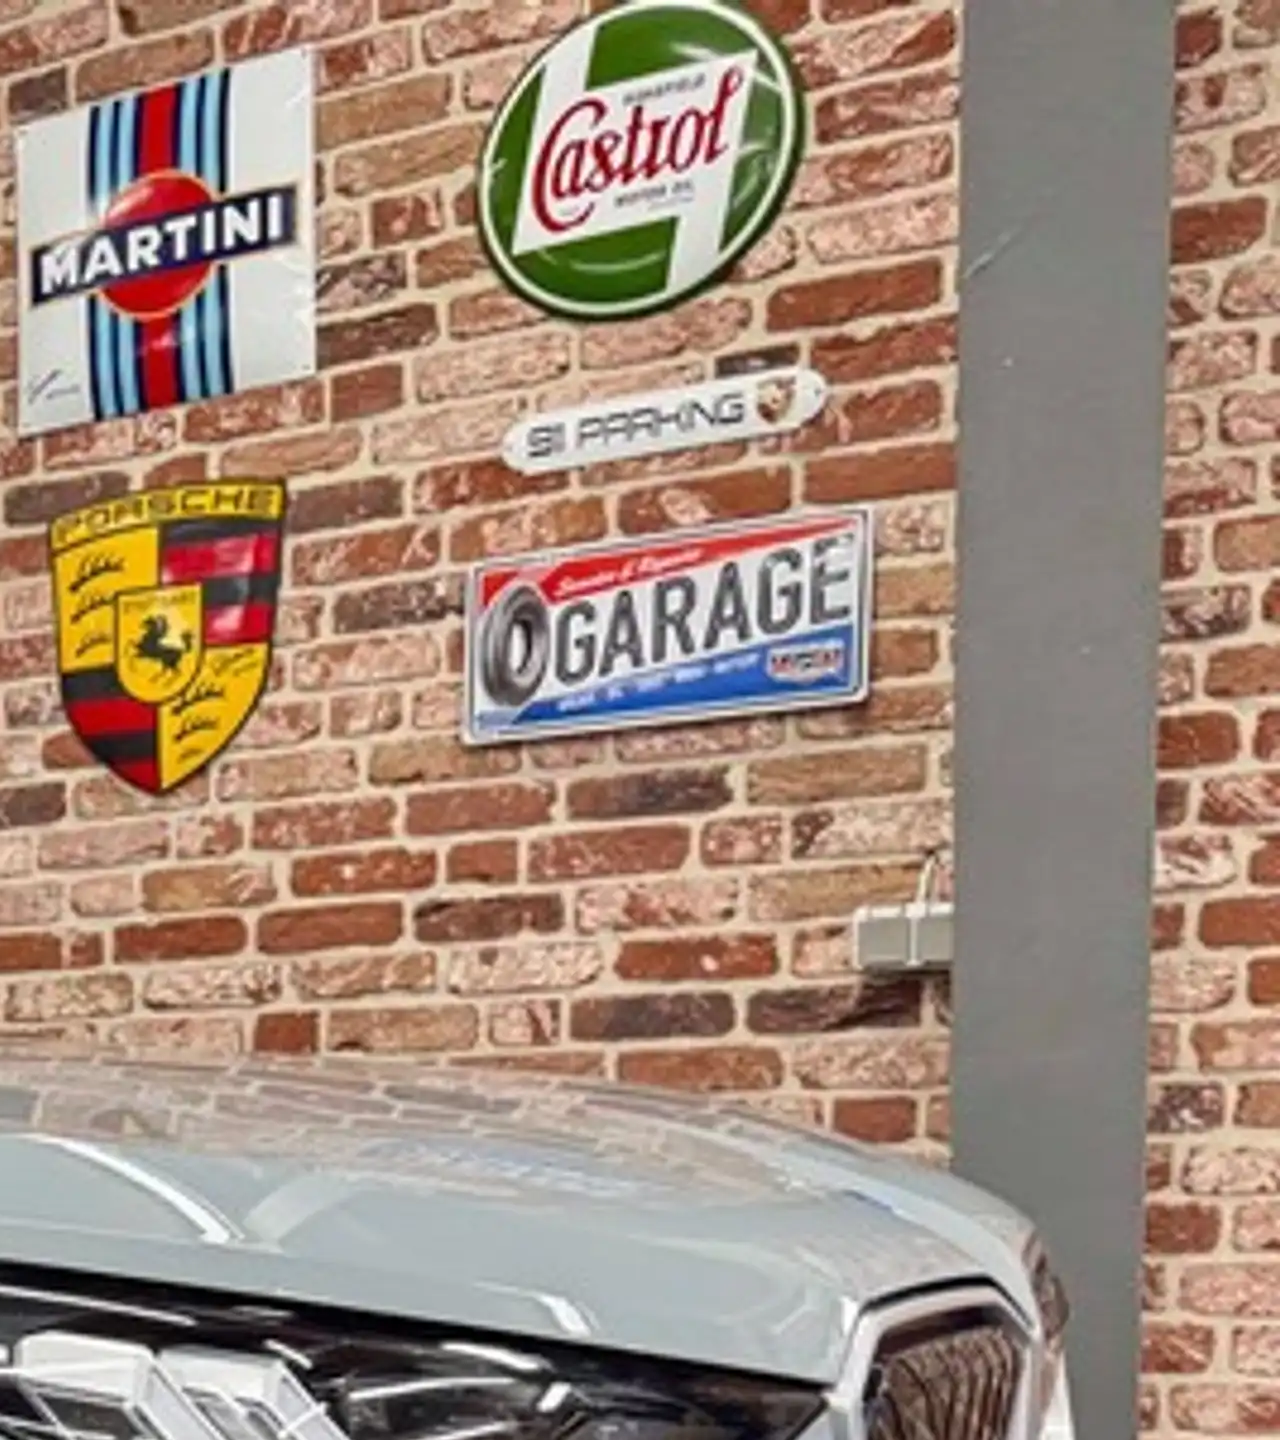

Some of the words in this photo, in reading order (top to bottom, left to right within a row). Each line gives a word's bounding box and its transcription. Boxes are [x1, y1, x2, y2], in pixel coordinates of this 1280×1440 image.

[532, 65, 744, 234] Castrol
[41, 195, 284, 295] MARTINI
[576, 392, 745, 449] PARKING
[555, 531, 855, 687] GARAGE
